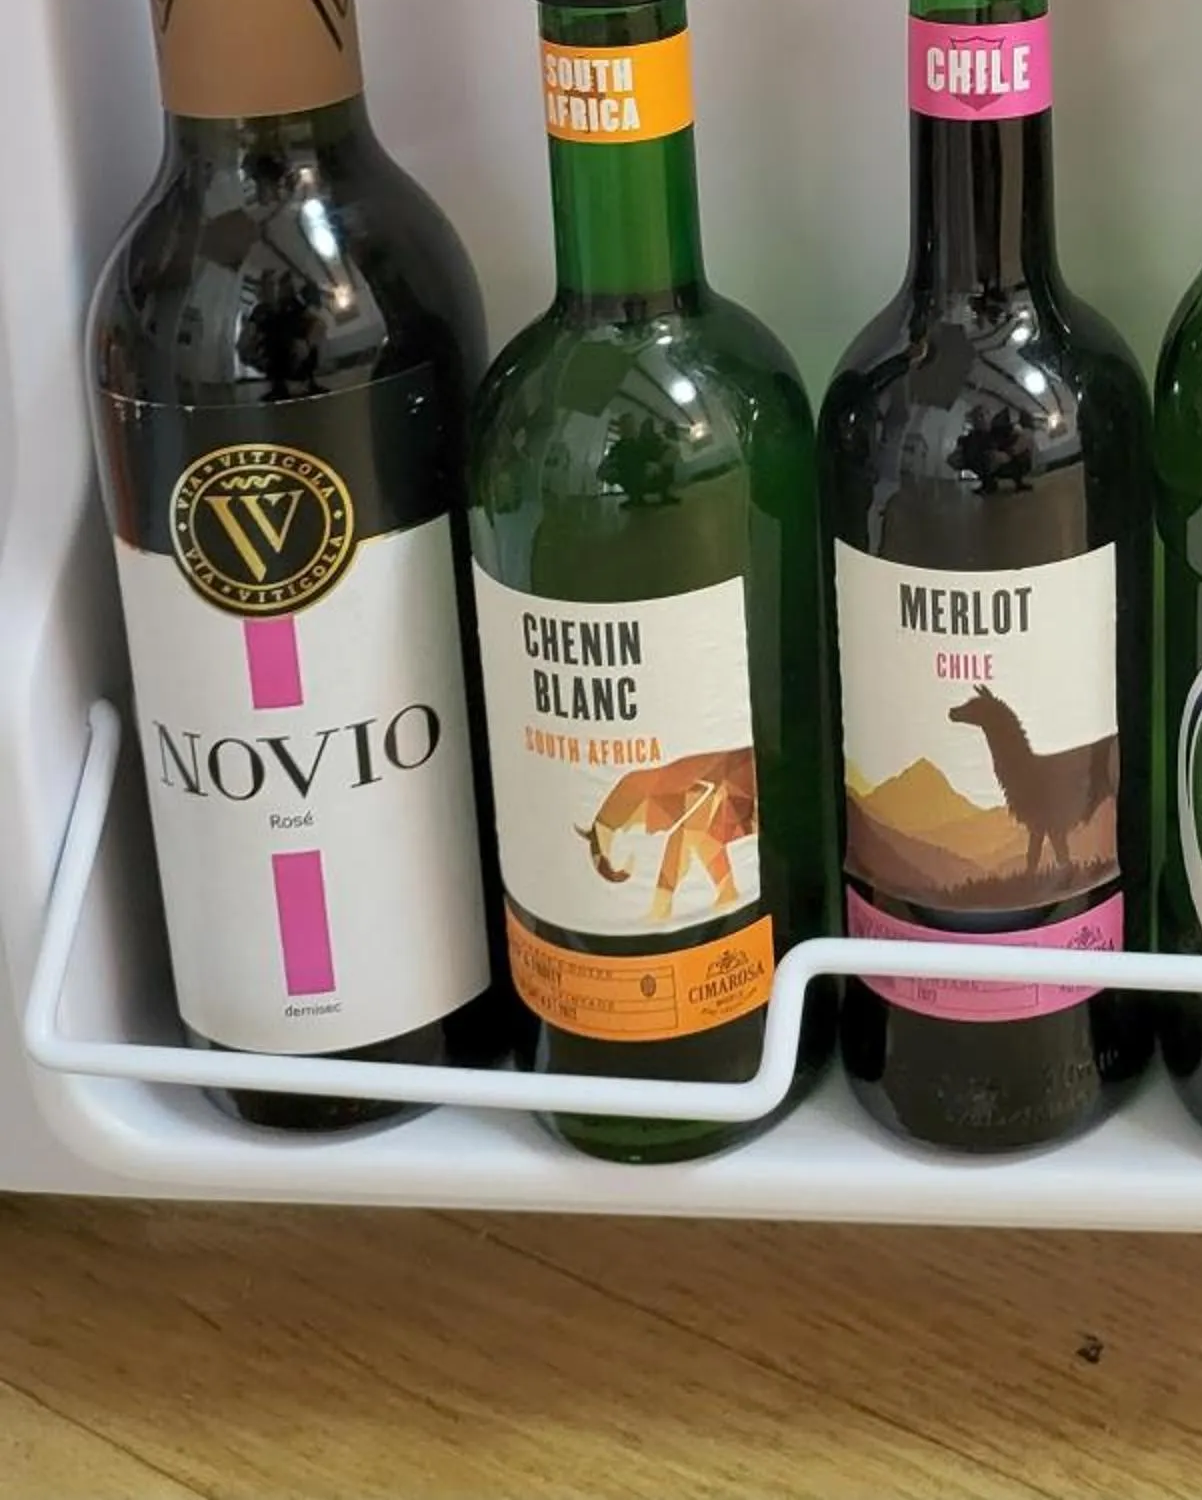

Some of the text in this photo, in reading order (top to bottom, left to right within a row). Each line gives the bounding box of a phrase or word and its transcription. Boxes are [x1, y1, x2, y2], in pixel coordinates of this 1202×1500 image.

[544, 53, 634, 93] SOUTH
[926, 44, 1032, 96] CHILE
[547, 93, 641, 133] AFRICA
[217, 450, 336, 499] VITICOLA
[237, 533, 345, 604] VITICOLA
[899, 582, 1033, 636] MERLOT
[522, 611, 642, 667] CHENIN
[935, 651, 994, 681] CHILE
[533, 669, 638, 722] BLANC
[151, 703, 441, 801] NOVIO
[524, 725, 662, 766] SOUTH AFRICA
[269, 810, 315, 830] Rosé
[687, 960, 766, 1005] CIMAROSA
[284, 1001, 343, 1018] demisec
